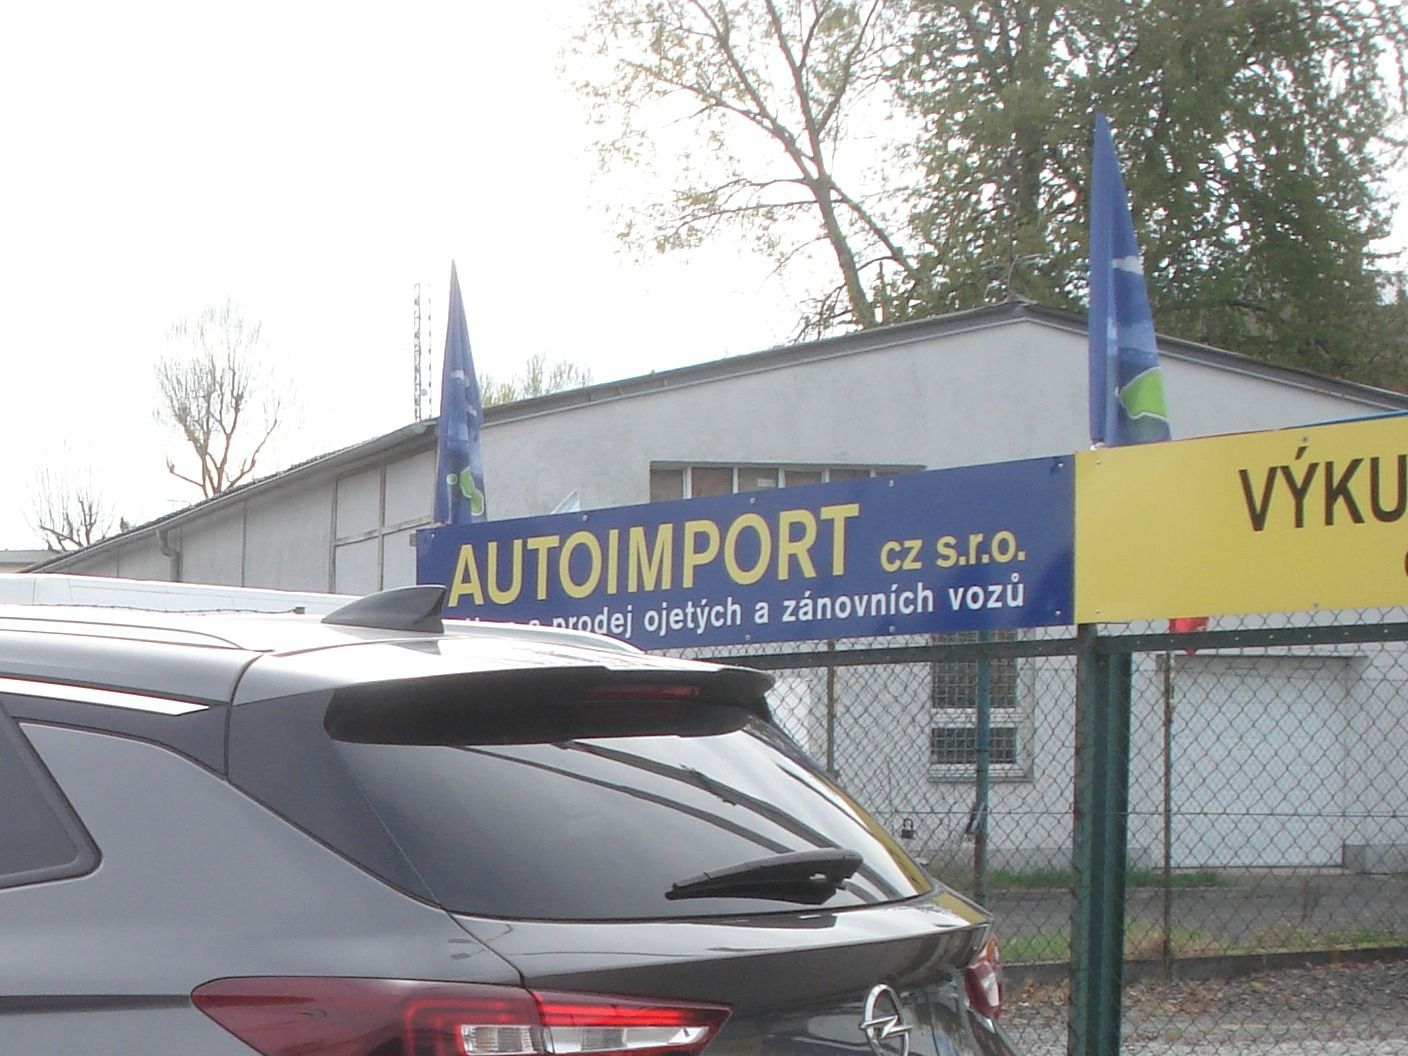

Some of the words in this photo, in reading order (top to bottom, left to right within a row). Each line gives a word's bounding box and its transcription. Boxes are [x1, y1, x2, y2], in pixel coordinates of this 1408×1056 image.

[1237, 445, 1408, 531] VÝKU
[448, 503, 860, 607] AUTOIMPORT
[880, 539, 923, 573] cz
[936, 530, 1026, 568] s.r.o.
[644, 596, 742, 636] ojetých
[754, 601, 769, 624] a
[782, 582, 934, 623] zánovních
[948, 572, 1024, 610] vozů
